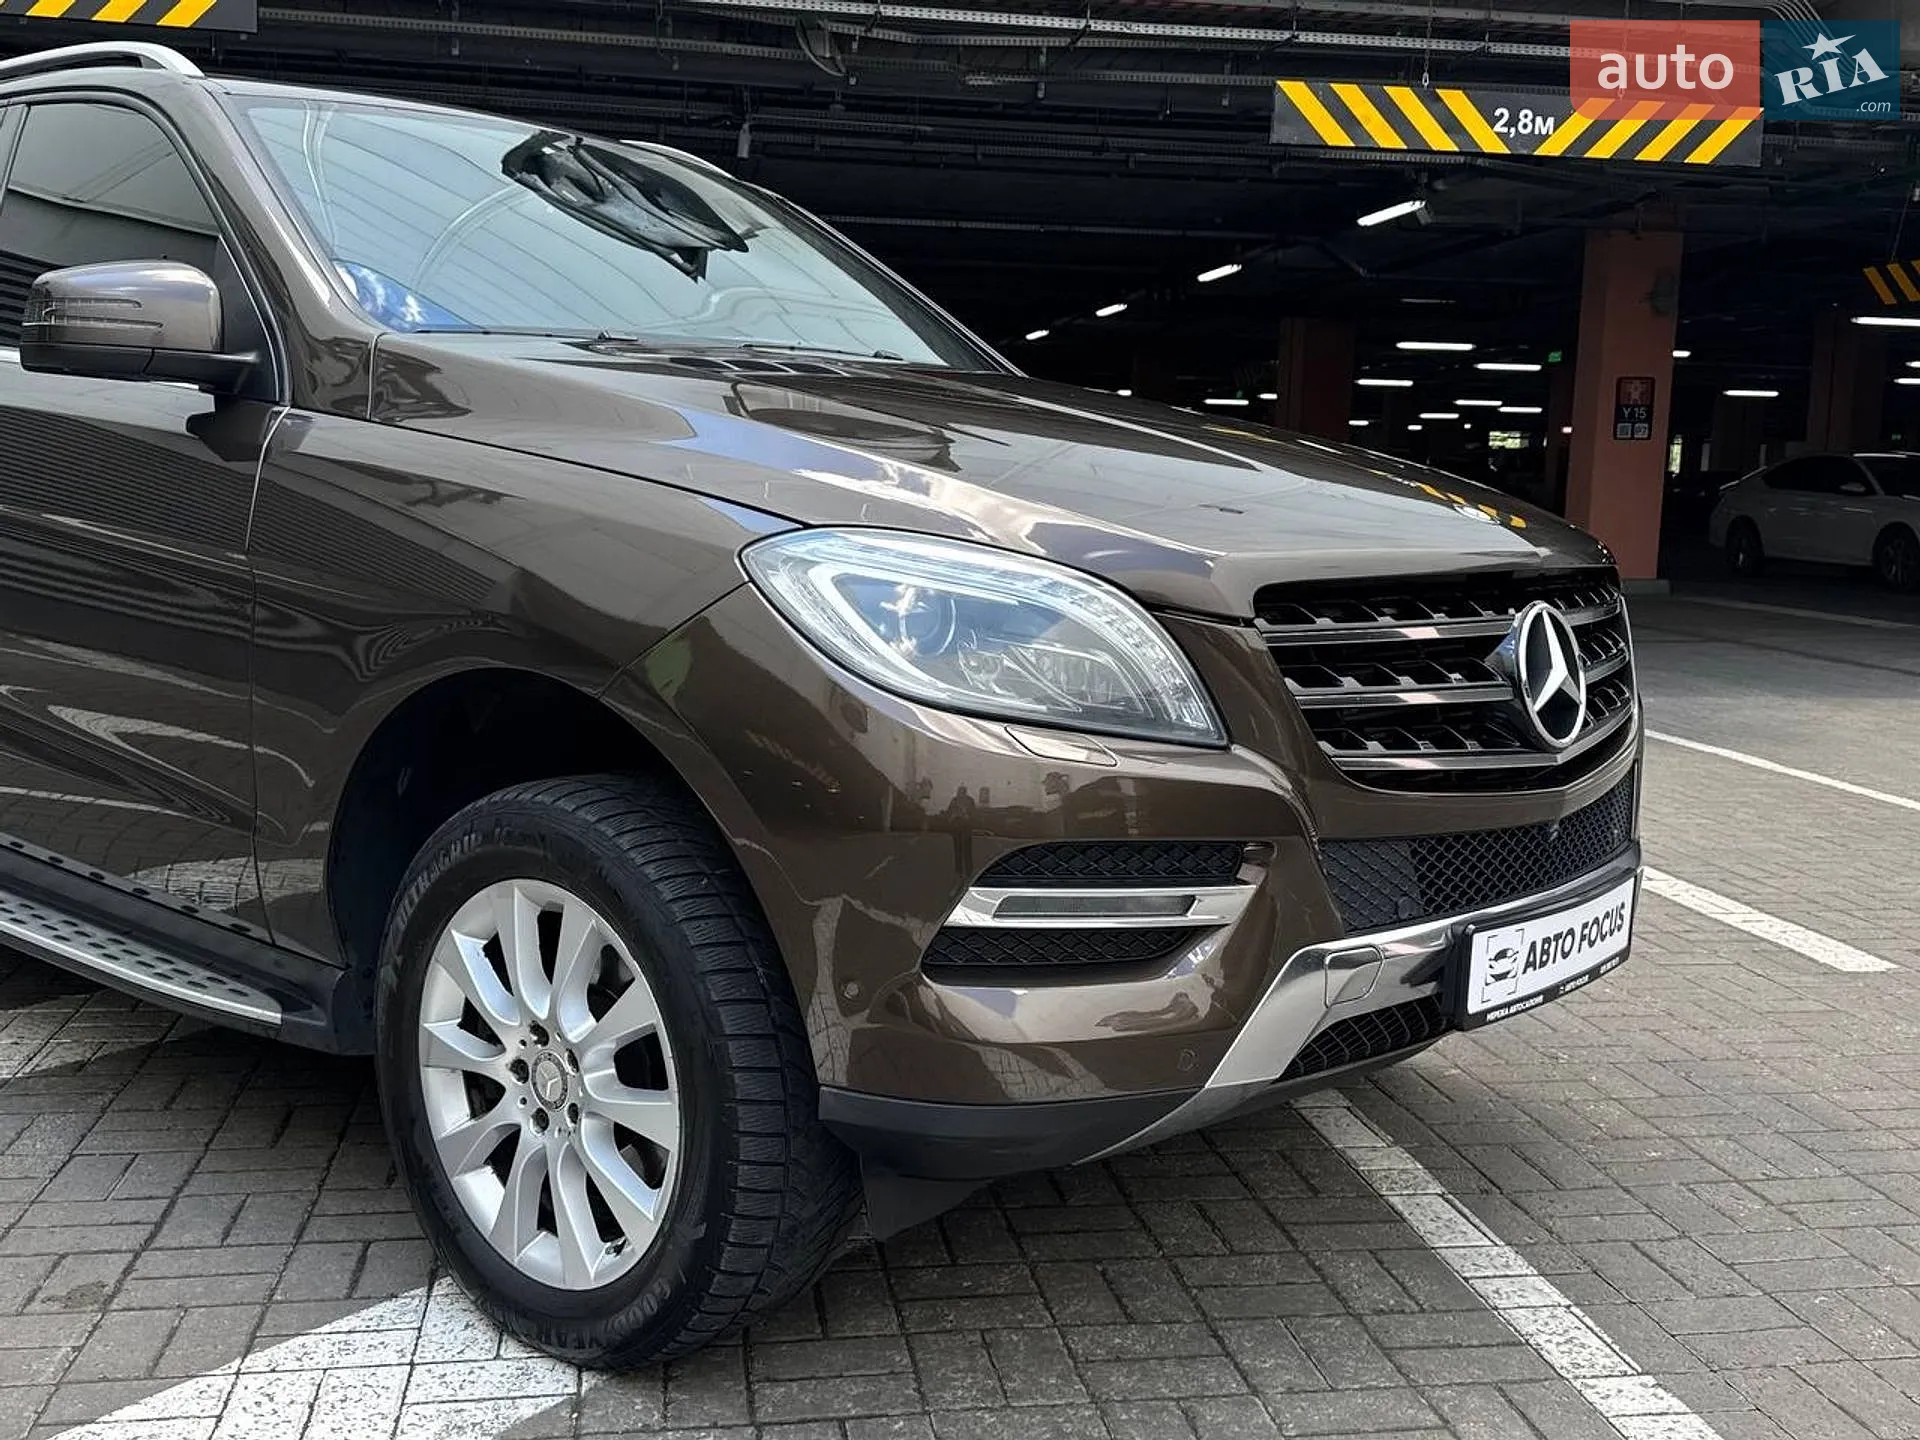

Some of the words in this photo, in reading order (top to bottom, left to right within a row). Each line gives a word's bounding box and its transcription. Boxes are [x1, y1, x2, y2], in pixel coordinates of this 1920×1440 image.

[1493, 107, 1555, 138] 2,8м
[1633, 407, 1647, 419] 15
[1522, 926, 1576, 975] АВТО
[1577, 901, 1626, 954] FOCUS
